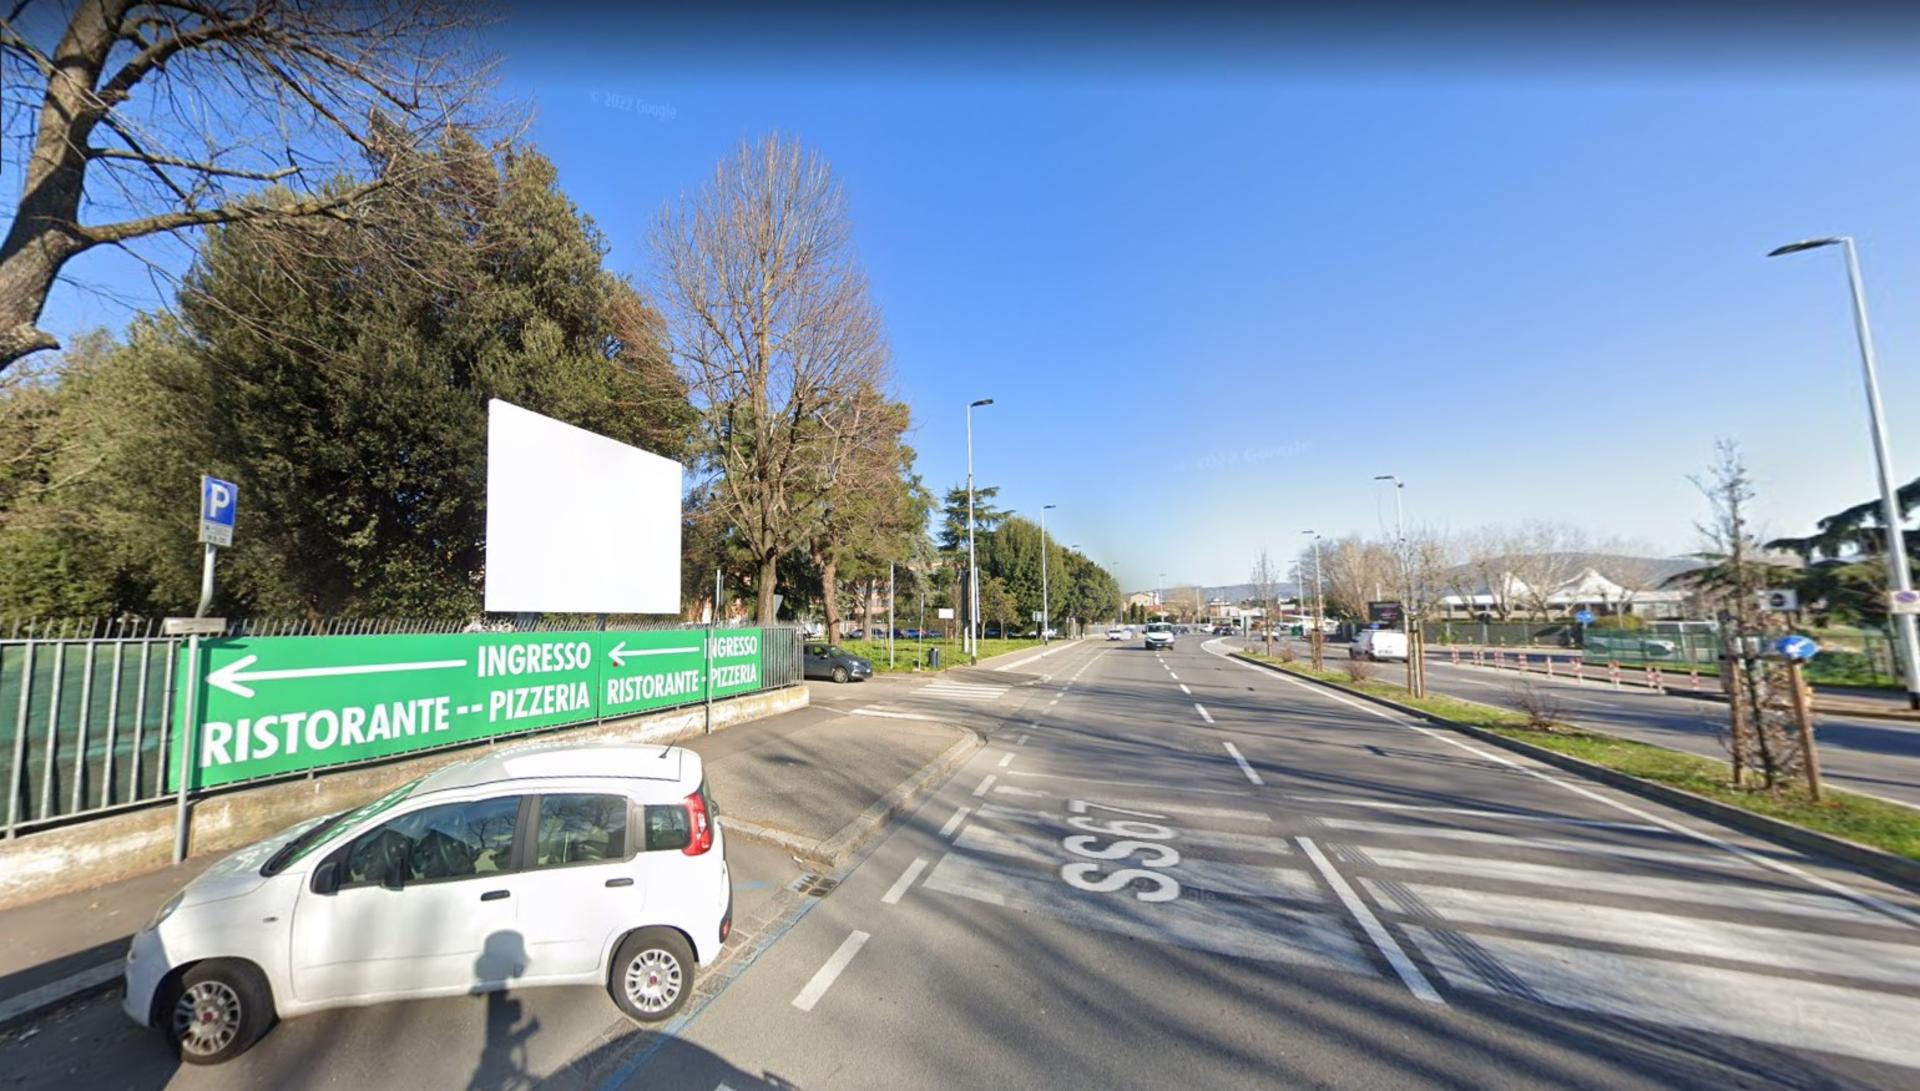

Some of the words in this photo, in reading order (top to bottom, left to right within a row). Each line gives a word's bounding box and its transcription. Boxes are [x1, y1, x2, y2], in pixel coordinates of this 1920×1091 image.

[210, 484, 230, 517] P
[477, 641, 592, 678] INGRESSO
[704, 635, 758, 659] INGRESSO
[607, 669, 699, 705] RISTORANTE
[710, 662, 757, 688] PIZZERIA
[200, 696, 450, 768] RISTORANTE
[488, 681, 590, 722] PIZZERIA
